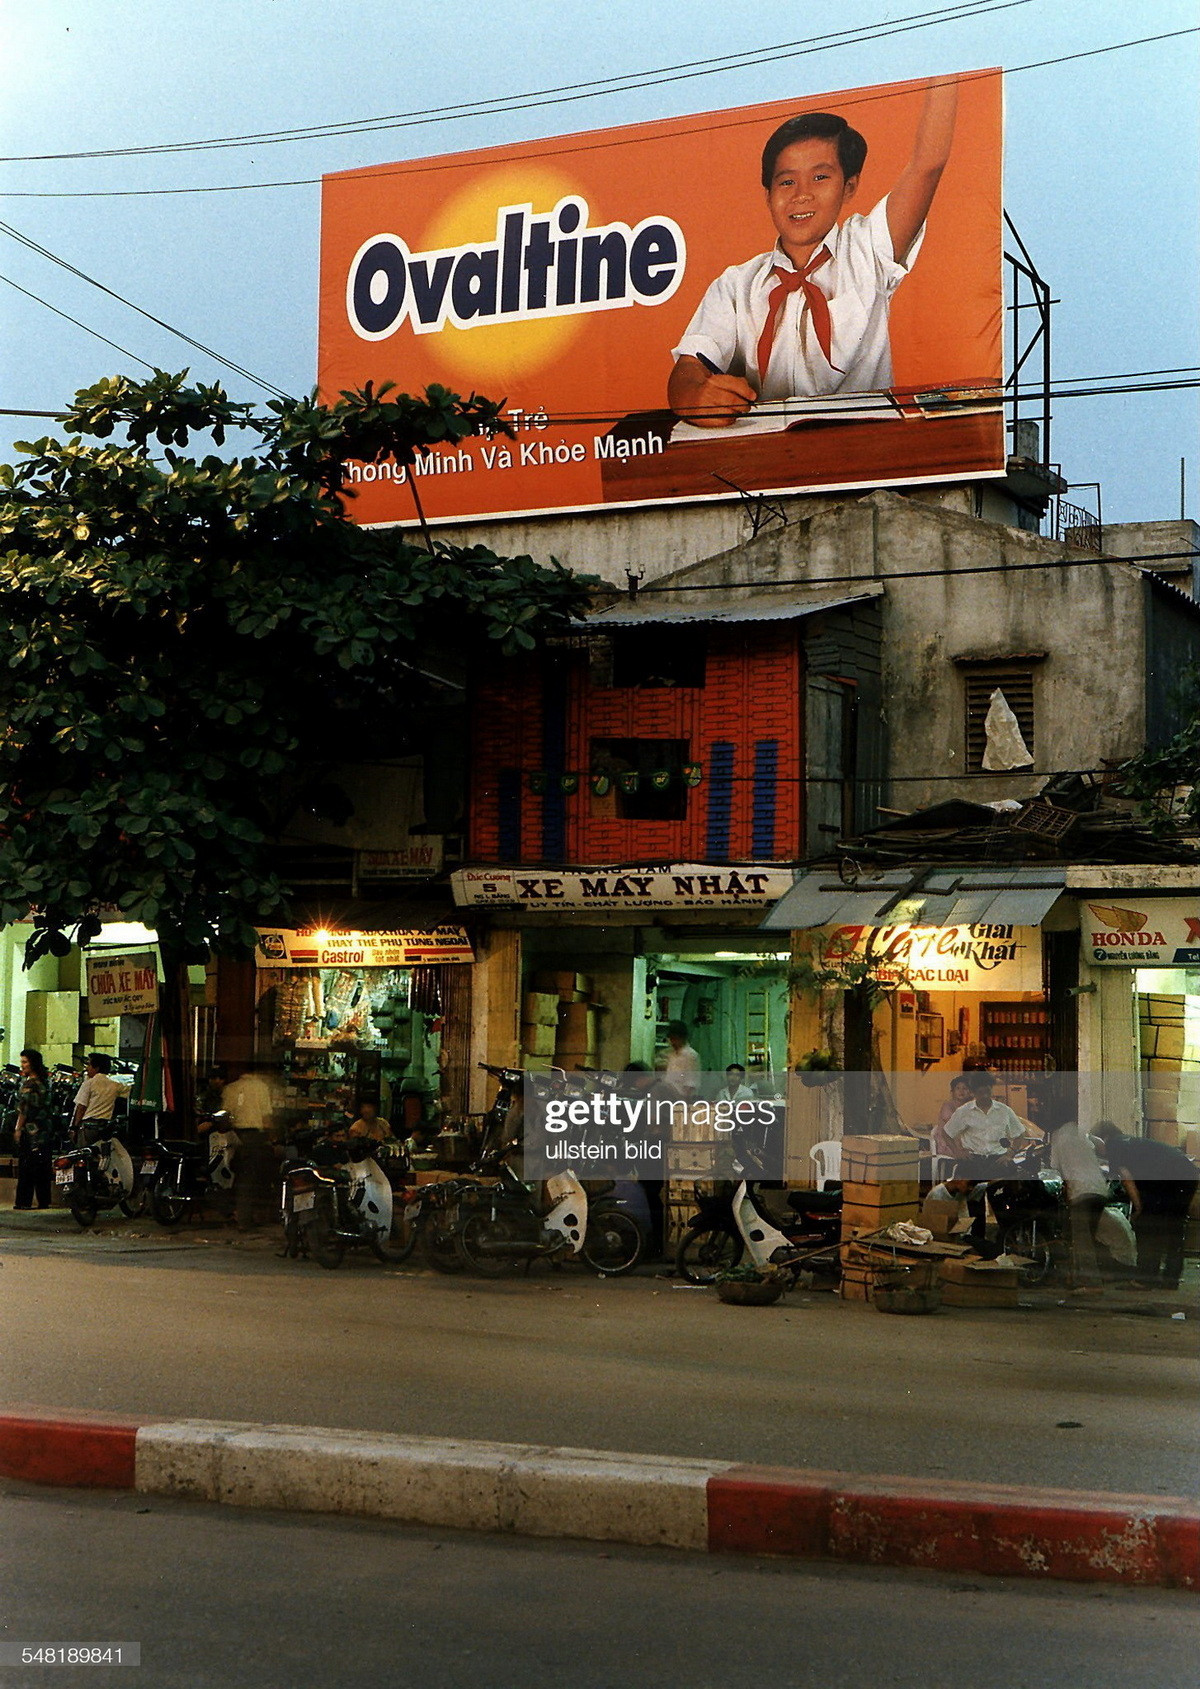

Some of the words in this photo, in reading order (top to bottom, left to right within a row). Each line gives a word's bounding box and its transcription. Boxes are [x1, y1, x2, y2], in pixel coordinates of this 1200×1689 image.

[350, 199, 682, 337] Ovaltine
[507, 406, 549, 432] Trẻ
[414, 451, 474, 477] Minh
[480, 446, 512, 470] Và
[520, 439, 586, 468] Khỏe
[594, 431, 664, 463] Mạnh
[516, 878, 566, 898] XE
[579, 875, 655, 897] MÁY
[671, 870, 769, 899] NHẬT
[1091, 932, 1167, 947] HONDA
[321, 950, 364, 964] Castrol
[964, 941, 1027, 970] Khát
[119, 972, 132, 993] XE
